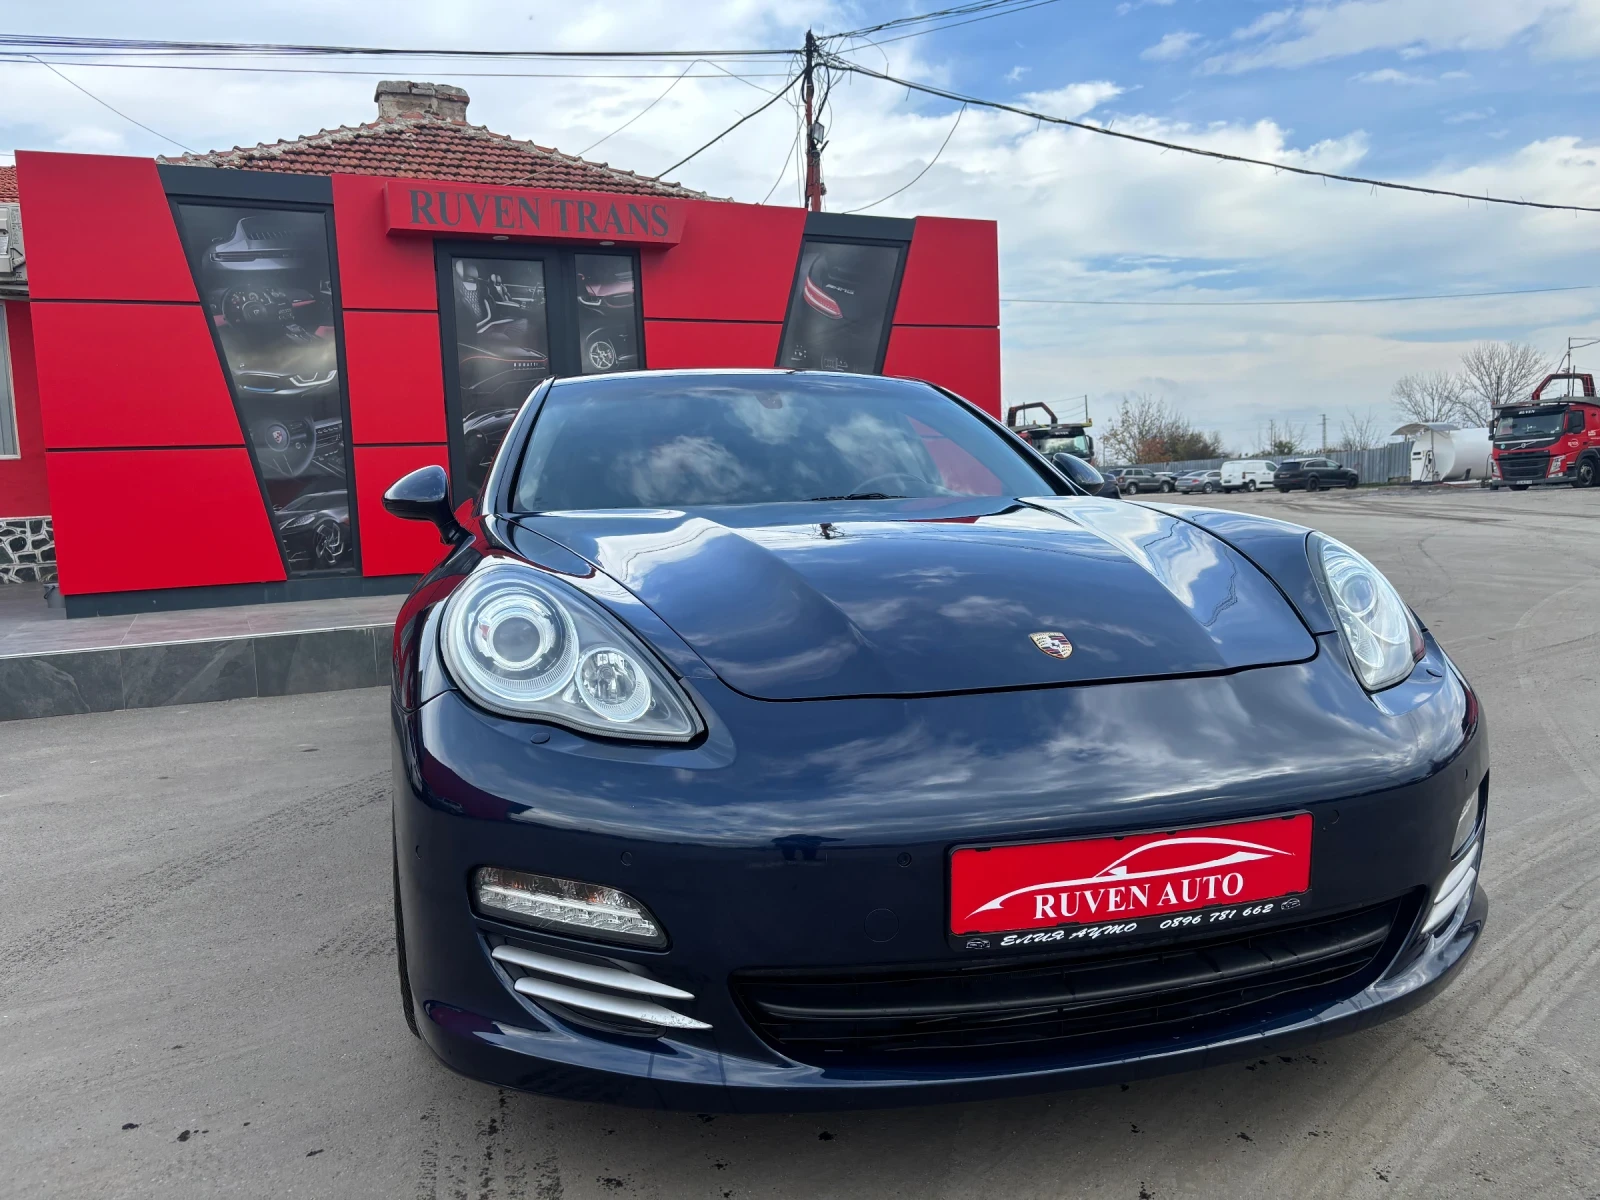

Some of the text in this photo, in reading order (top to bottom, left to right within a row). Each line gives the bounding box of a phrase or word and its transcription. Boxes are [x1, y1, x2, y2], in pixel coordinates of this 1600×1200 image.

[408, 189, 669, 237] RUVEN TRANS
[1033, 872, 1244, 919] RUVEN AUTO
[1159, 914, 1203, 929] 0896
[1209, 909, 1237, 923] 781
[1242, 903, 1274, 917] 662
